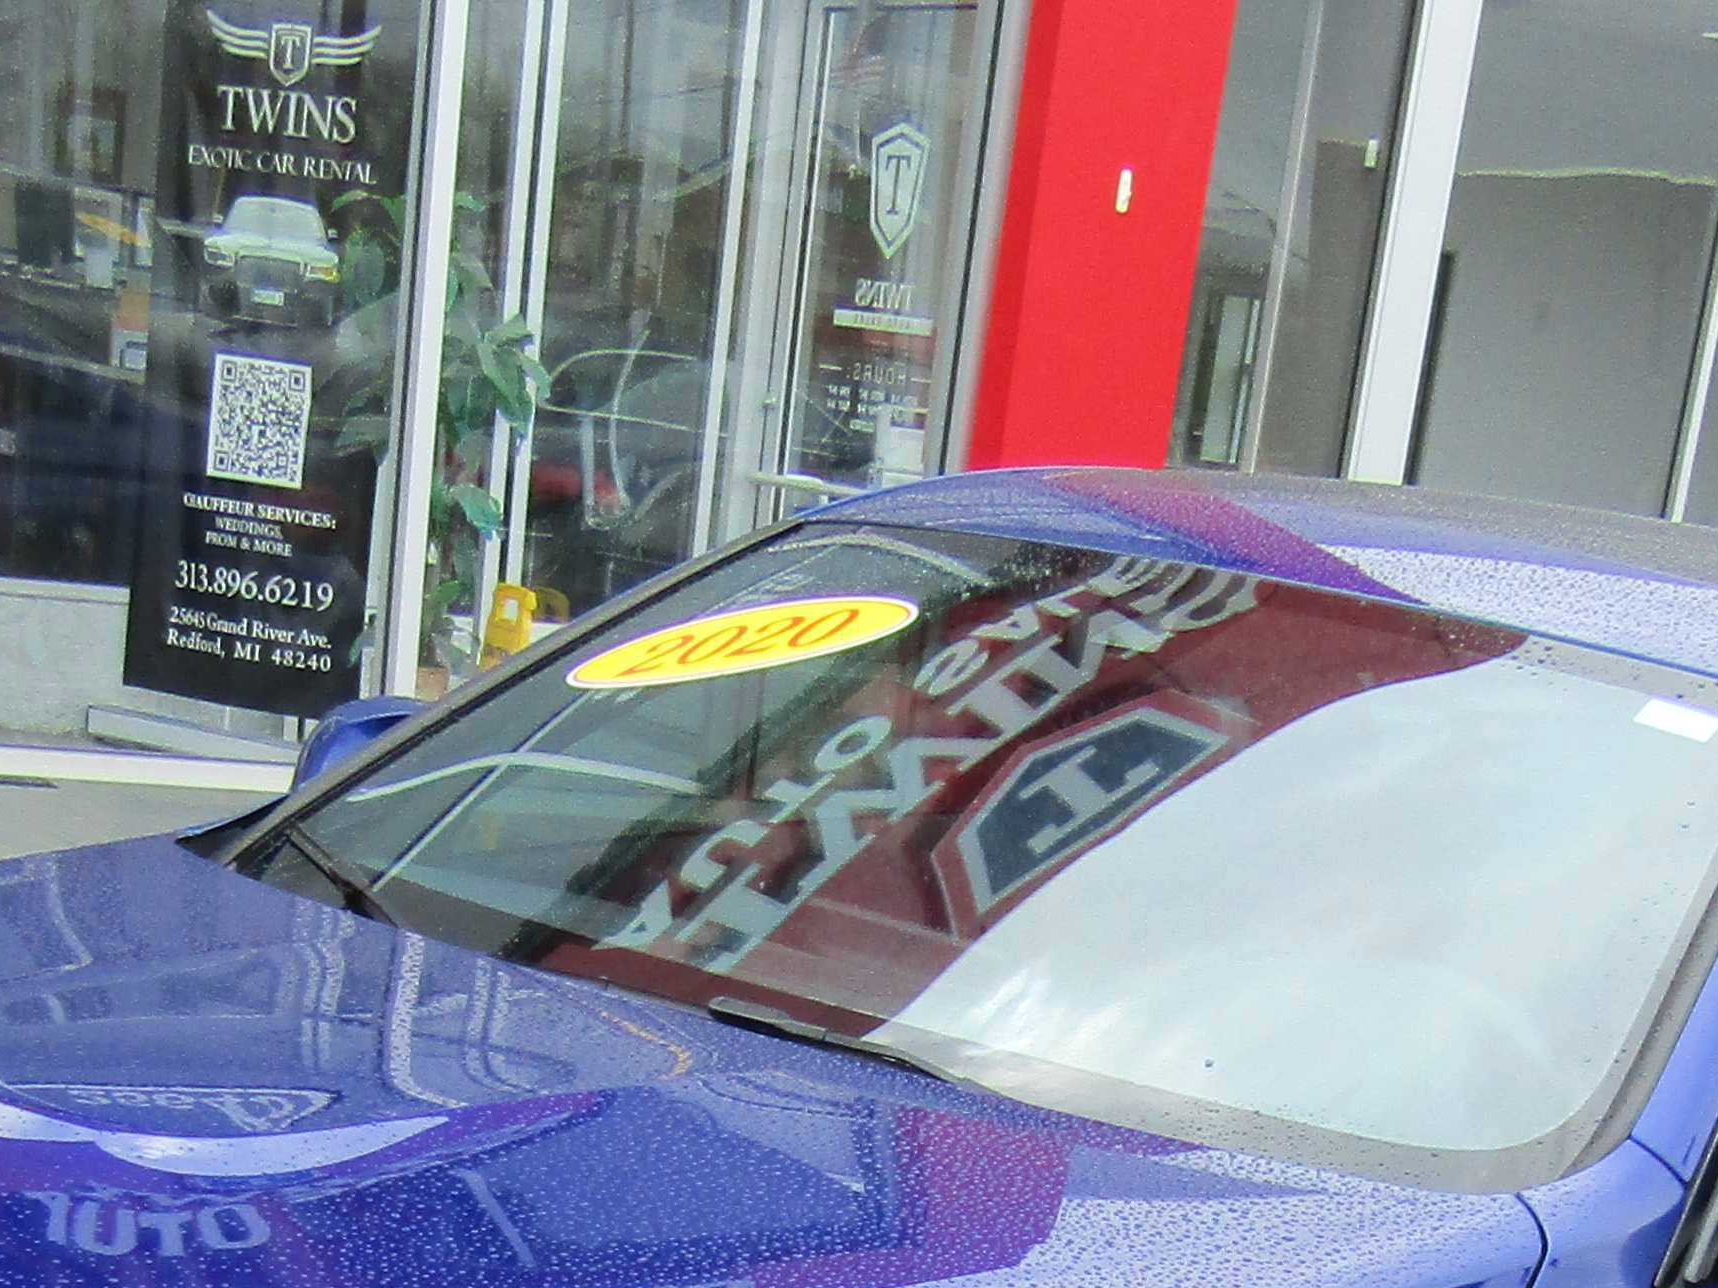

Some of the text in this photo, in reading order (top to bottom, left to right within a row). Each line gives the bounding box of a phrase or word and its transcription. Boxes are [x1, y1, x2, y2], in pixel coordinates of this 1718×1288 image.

[218, 87, 358, 144] TWINS
[187, 144, 378, 184] EXOTIC CAR RENTAL
[884, 154, 913, 216] T
[257, 504, 337, 530] SERVICES:
[239, 537, 251, 551] &
[252, 539, 293, 558] MORE
[174, 558, 335, 612] 313.896.6219
[166, 628, 332, 673] Redford, MI 48240
[206, 612, 248, 637] Grand
[252, 620, 295, 644] River
[297, 629, 332, 649] Ave.
[614, 607, 861, 679] 2020
